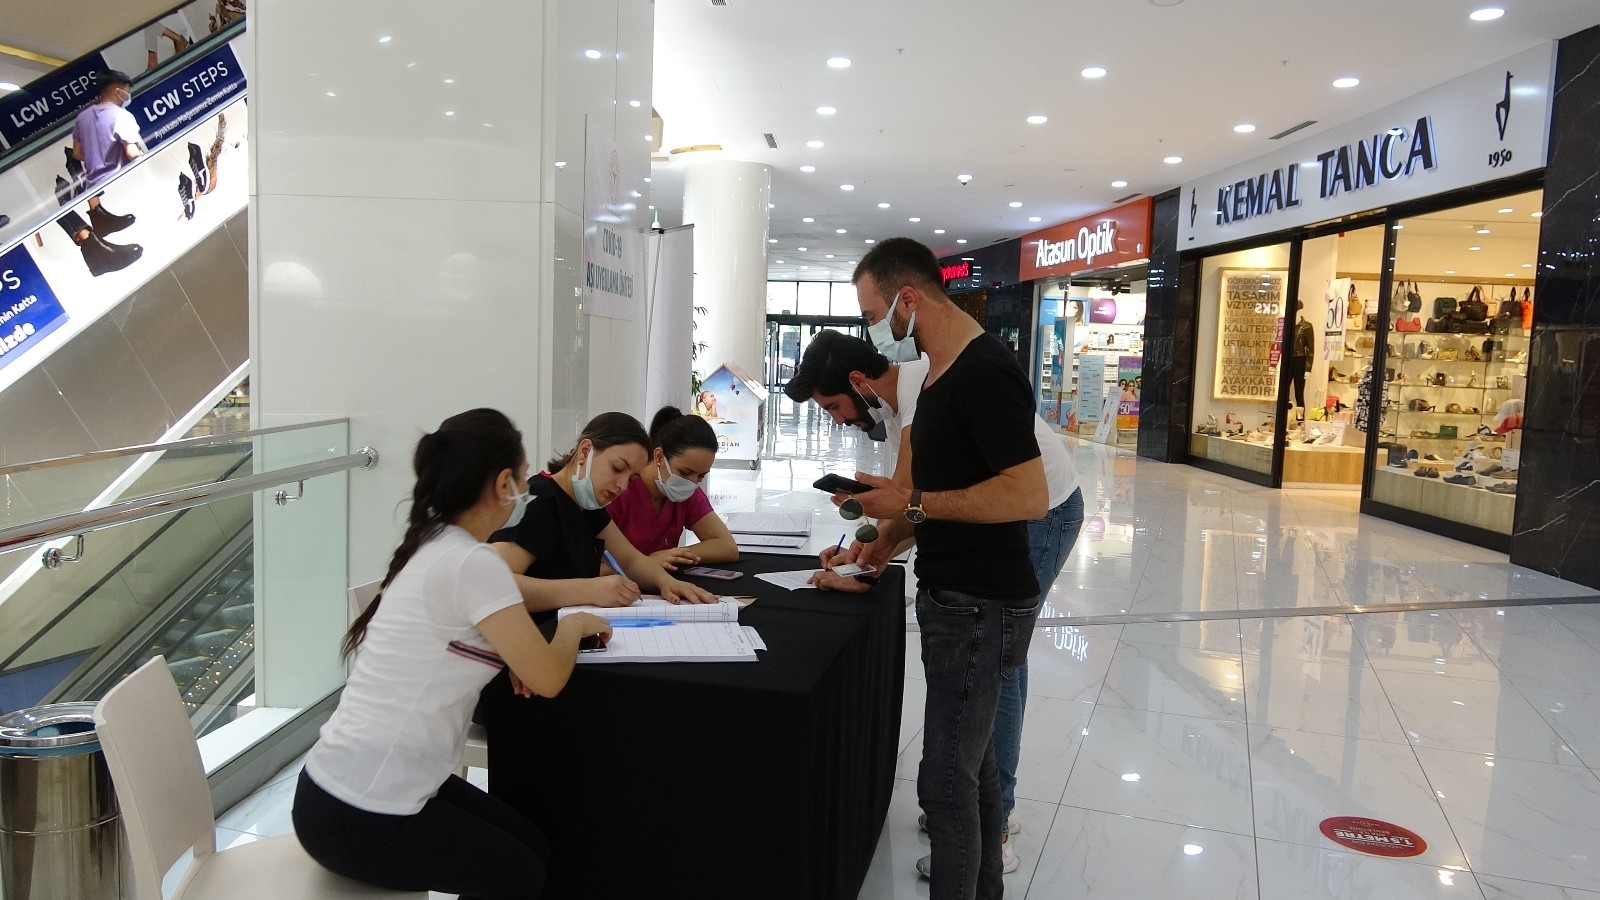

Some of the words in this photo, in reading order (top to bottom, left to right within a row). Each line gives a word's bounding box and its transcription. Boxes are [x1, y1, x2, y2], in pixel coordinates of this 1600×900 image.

[143, 89, 180, 122] LCW
[182, 61, 228, 98] STEPS
[10, 97, 49, 128] LCW
[1216, 163, 1302, 225] KEMAL
[1317, 117, 1438, 198] TANCA
[1488, 148, 1512, 168] 1950
[1036, 239, 1076, 268] Atasun
[1078, 220, 1114, 265] Optik
[11, 294, 38, 315] Katta
[1120, 403, 1130, 415] 50
[1334, 830, 1390, 843] METRE
